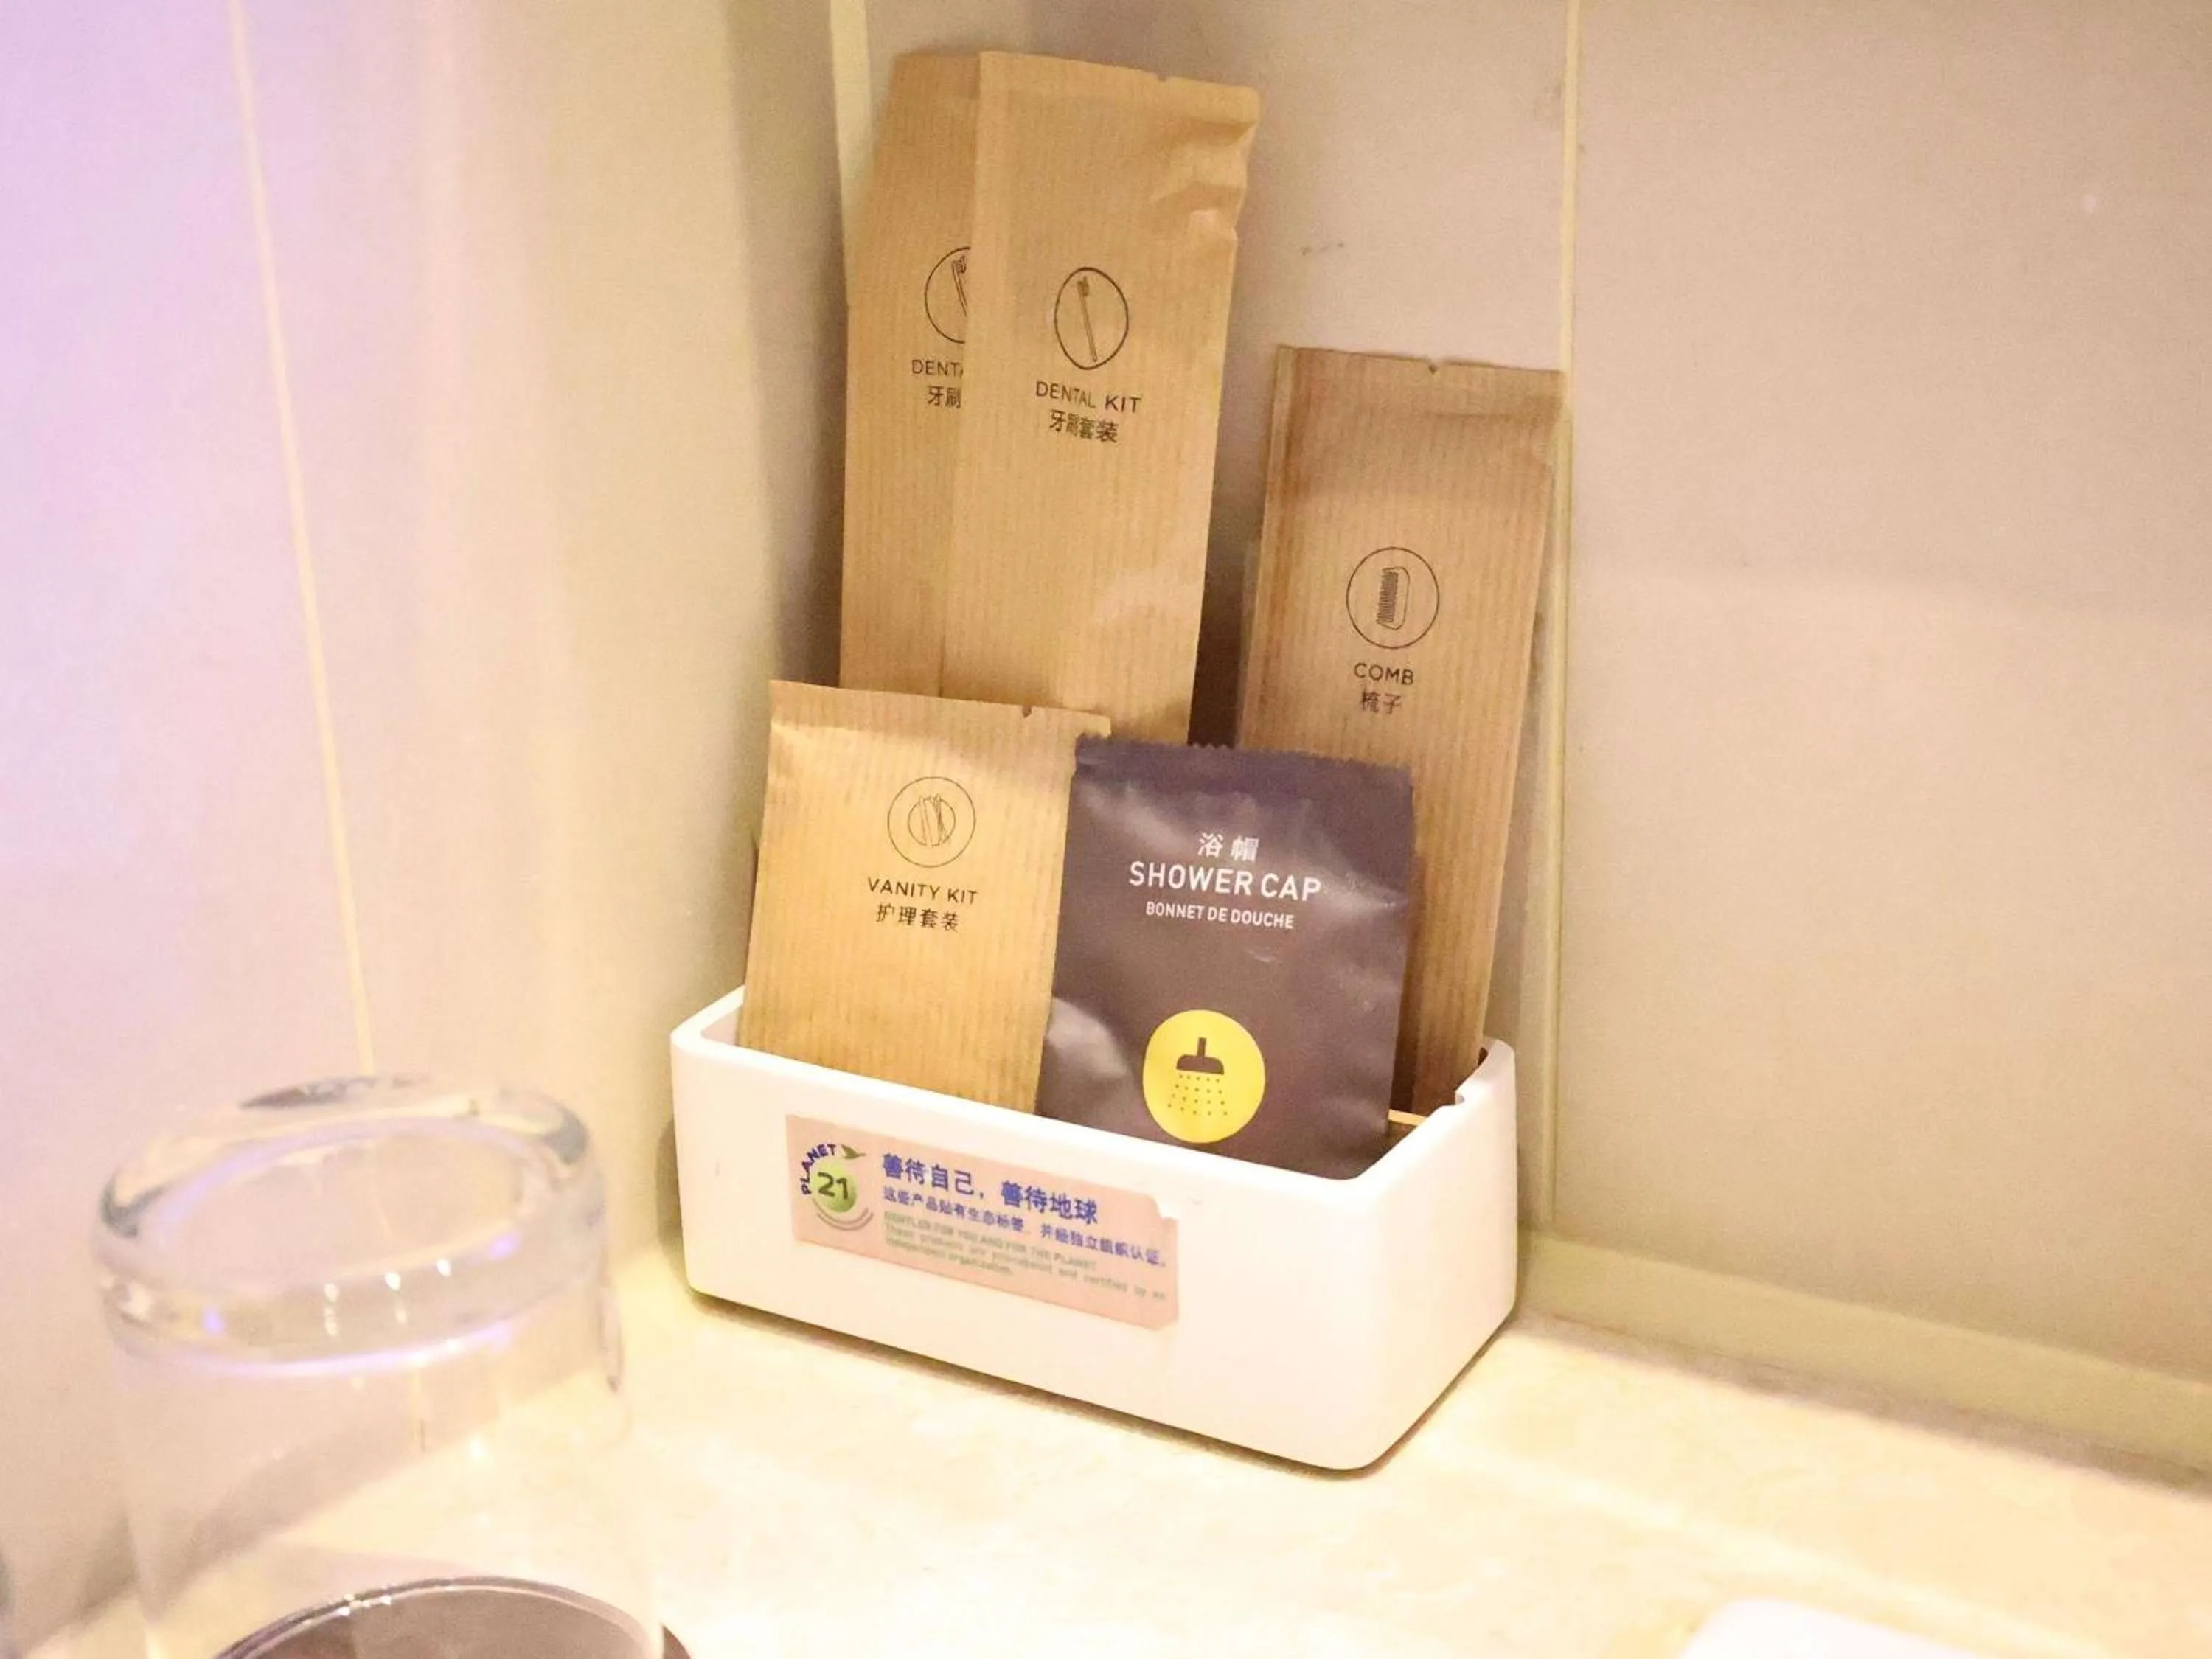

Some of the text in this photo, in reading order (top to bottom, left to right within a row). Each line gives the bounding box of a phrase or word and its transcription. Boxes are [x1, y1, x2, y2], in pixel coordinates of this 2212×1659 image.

[1036, 380, 1142, 414] DENTAL KIT
[1049, 408, 1119, 444] 牙刷套装
[1354, 662, 1414, 685] COMB
[1360, 688, 1402, 715] 梳子
[867, 876, 979, 906] VANITY KIT
[1129, 860, 1322, 902] SHOWER CAP
[875, 902, 960, 933] 护理套装
[1146, 901, 1295, 930] BONNET DE DOUCHE
[799, 1144, 838, 1195] PLANET
[817, 1172, 849, 1200] 21
